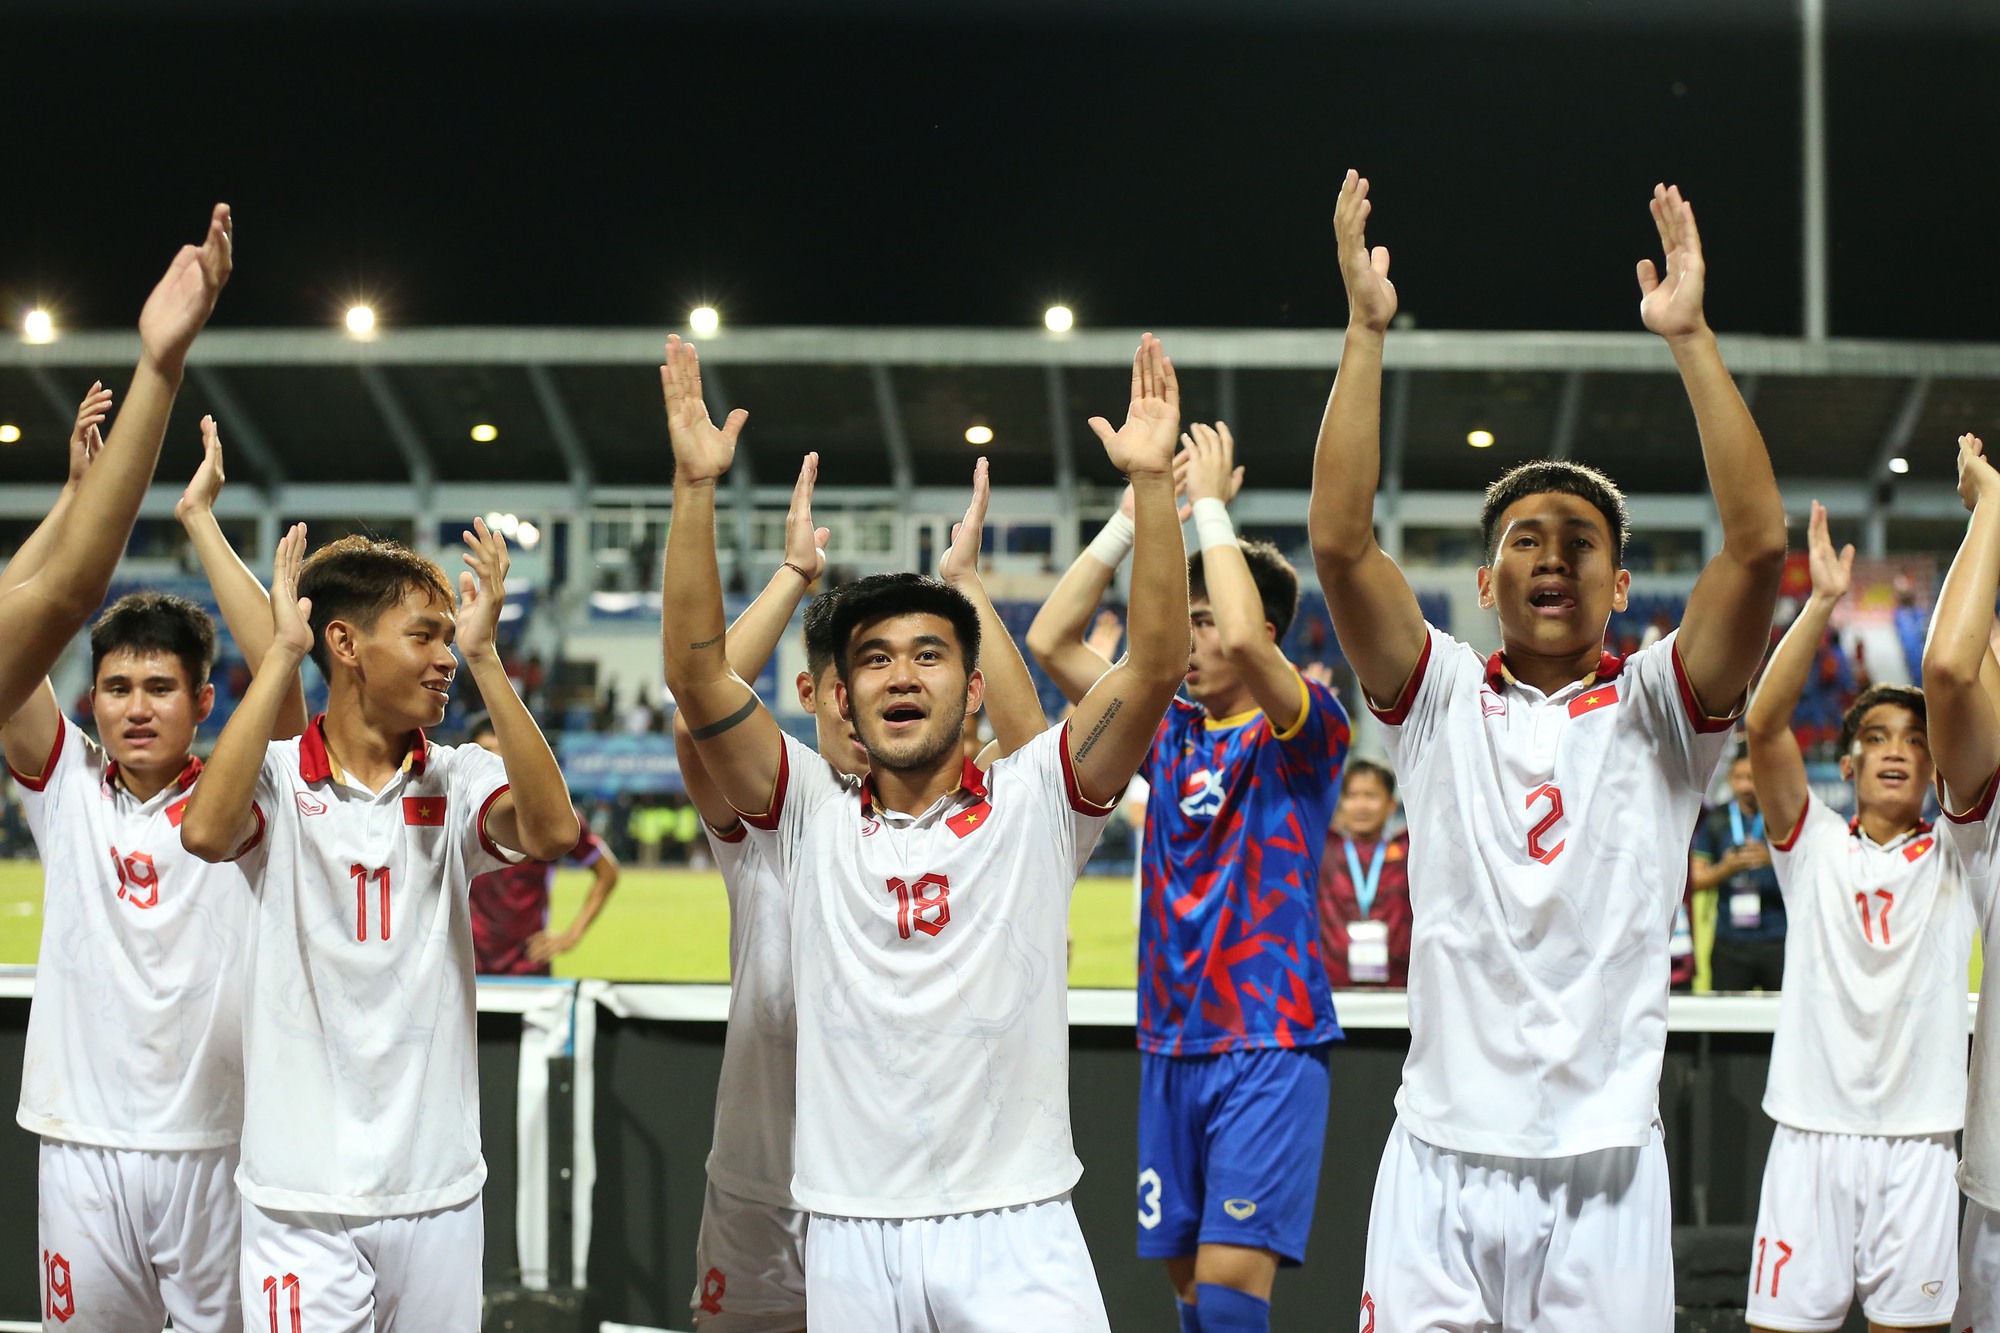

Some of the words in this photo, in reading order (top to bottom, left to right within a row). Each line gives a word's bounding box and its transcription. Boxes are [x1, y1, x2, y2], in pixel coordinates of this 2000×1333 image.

[1091, 724, 1100, 735] LIKE
[1525, 784, 1566, 866] 2
[111, 847, 160, 909] 19
[350, 863, 392, 942] 11
[886, 872, 952, 940] 18
[1855, 889, 1894, 945] 17
[43, 1248, 76, 1323] 19
[1757, 1236, 1793, 1298] 17
[262, 1271, 303, 1333] 11
